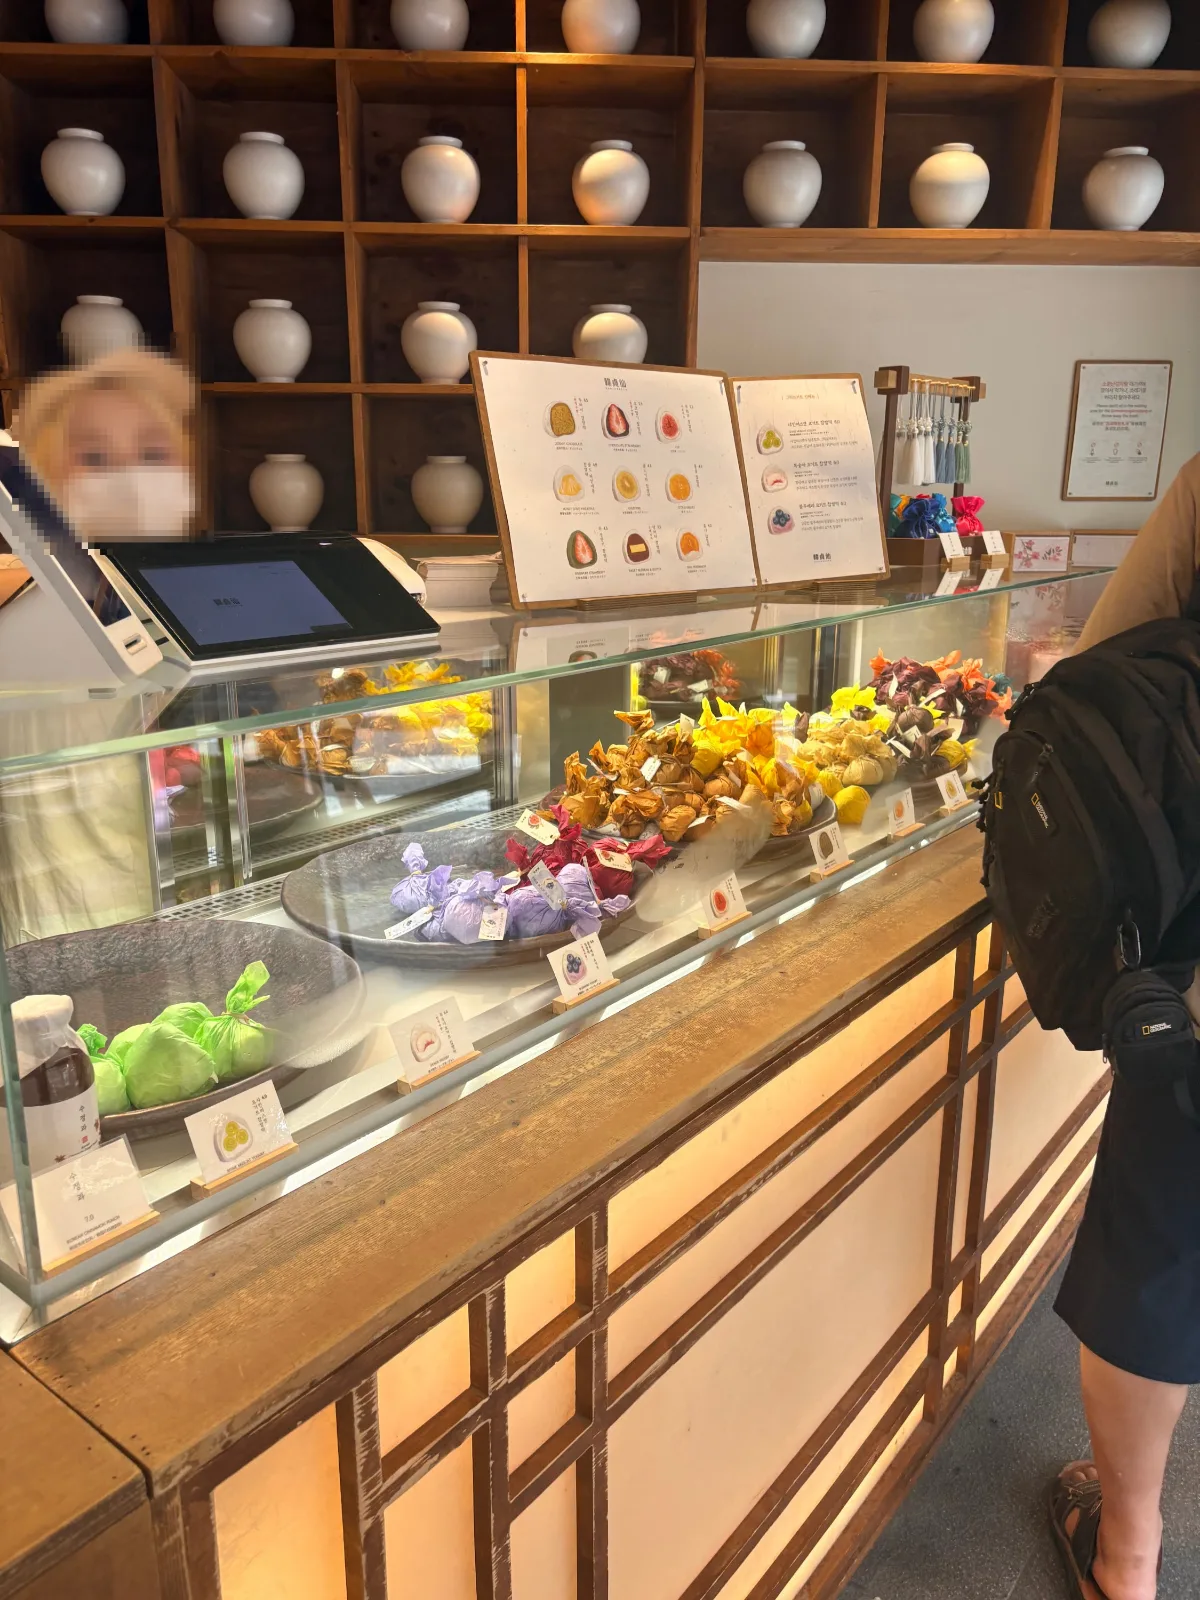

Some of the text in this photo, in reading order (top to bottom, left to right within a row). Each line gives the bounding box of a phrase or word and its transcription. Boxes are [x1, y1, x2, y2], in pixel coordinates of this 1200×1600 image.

[79, 1105, 87, 1132] 수정과
[69, 1172, 86, 1201] 수정과
[84, 1213, 95, 1222] 7.0
